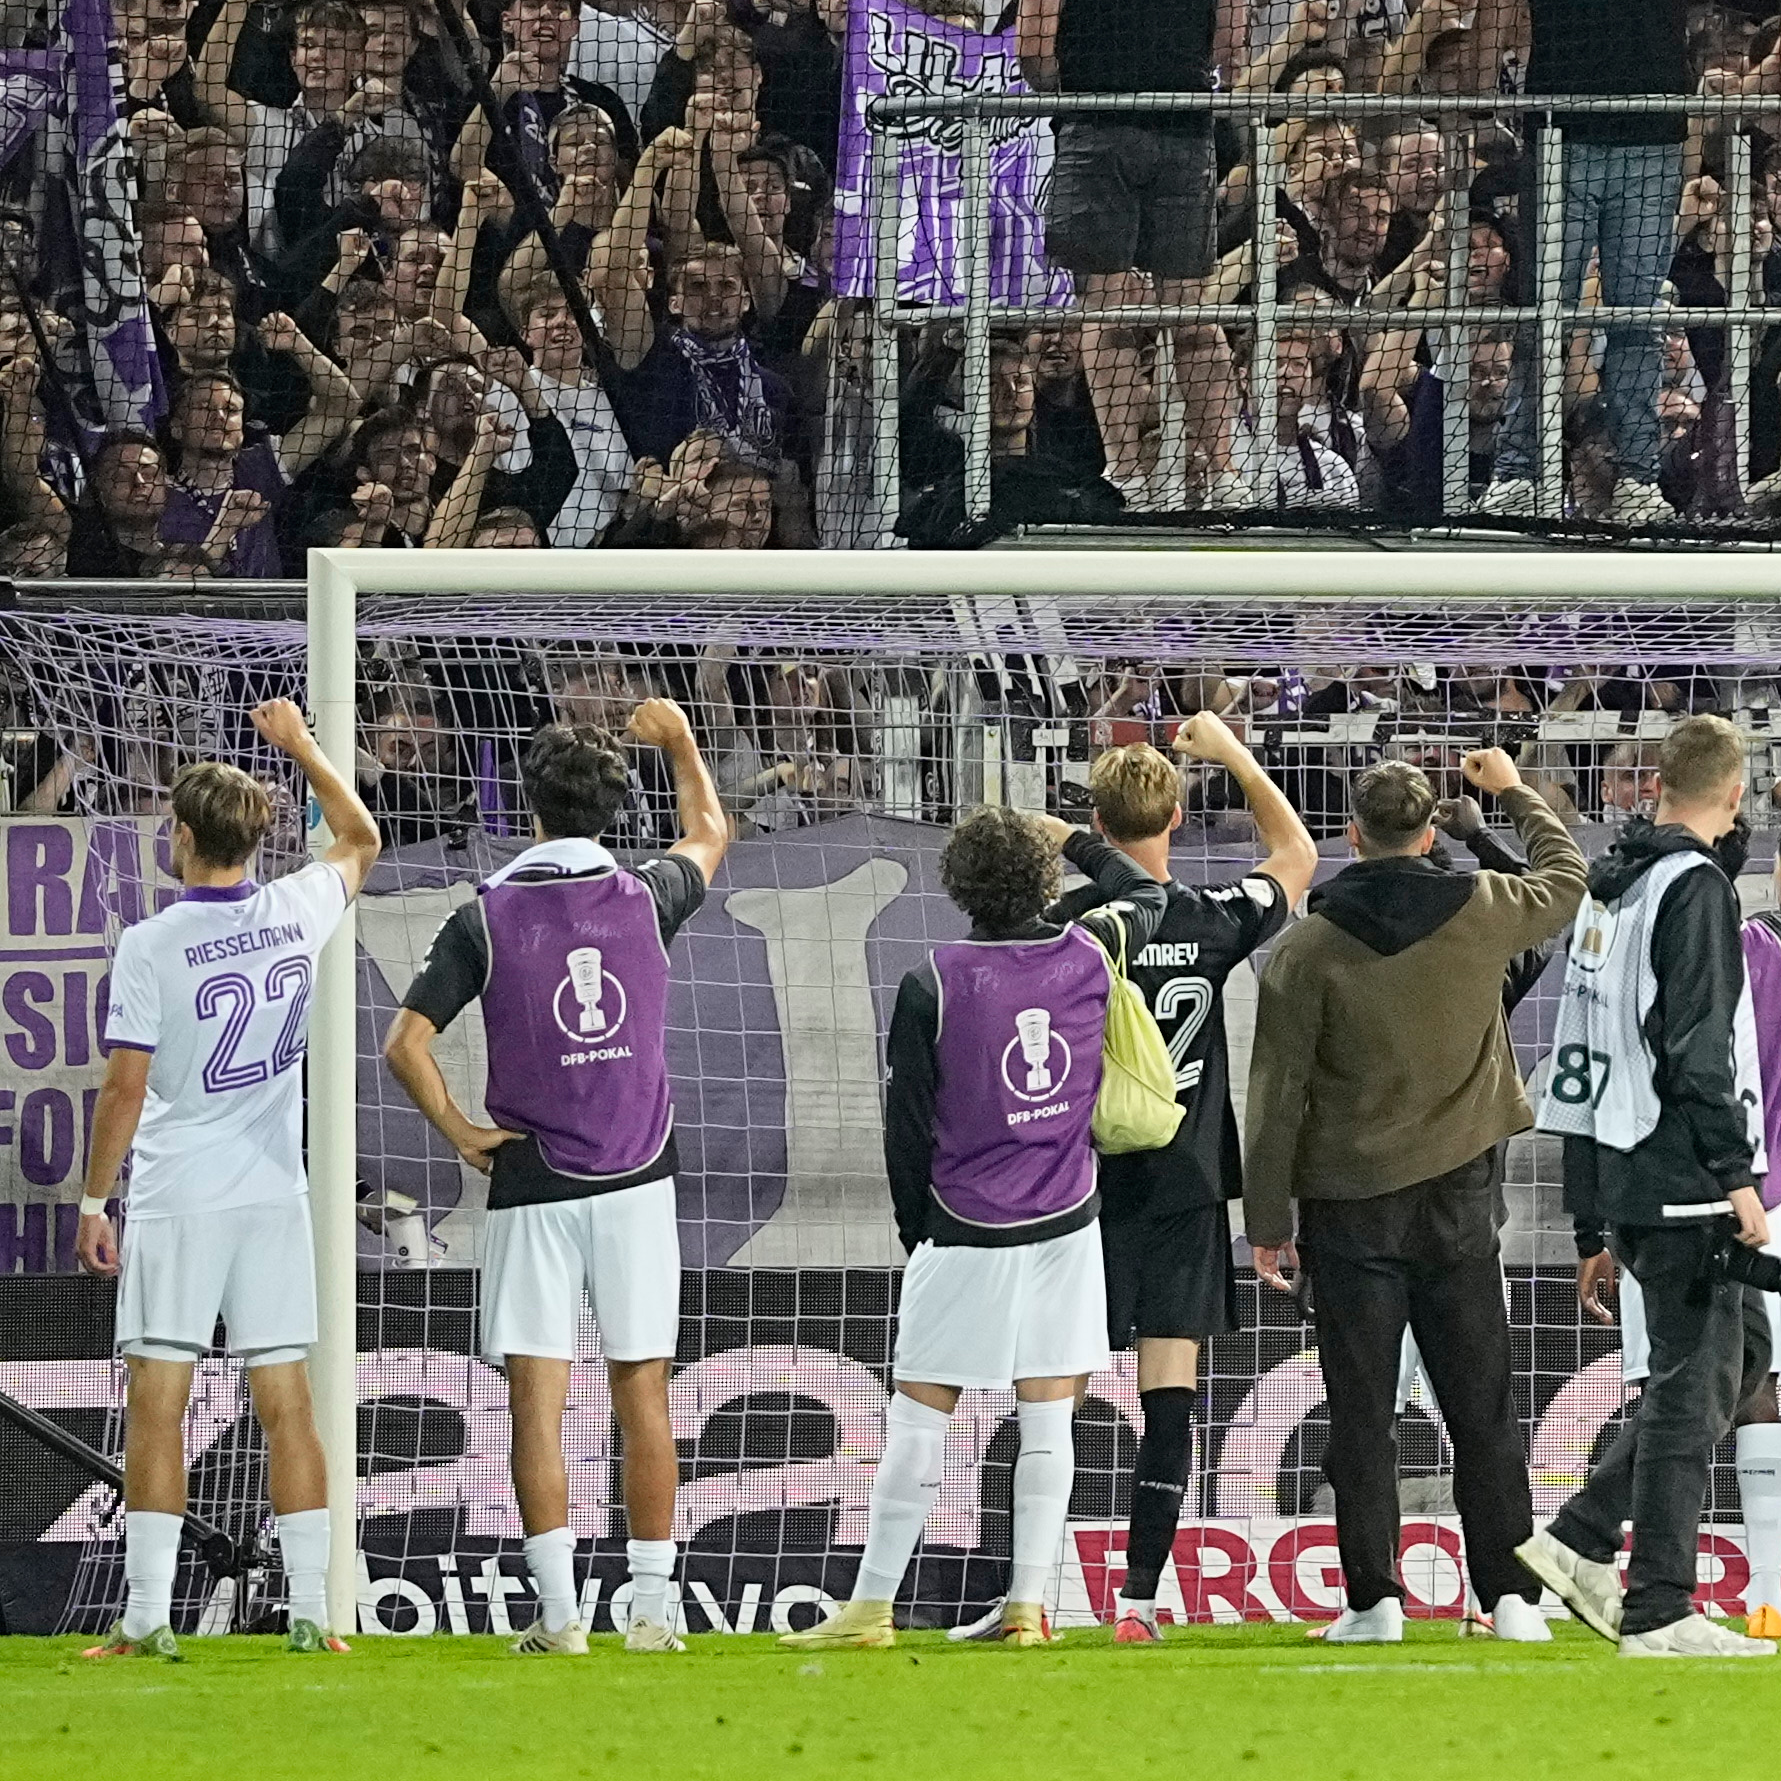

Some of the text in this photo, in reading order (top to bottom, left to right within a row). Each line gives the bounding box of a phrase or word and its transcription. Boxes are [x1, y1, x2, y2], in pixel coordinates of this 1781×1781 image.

[196, 953, 312, 1094] 22
[560, 1045, 633, 1066] DFB-POKAL
[1007, 1100, 1070, 1126] DFB-POKAL
